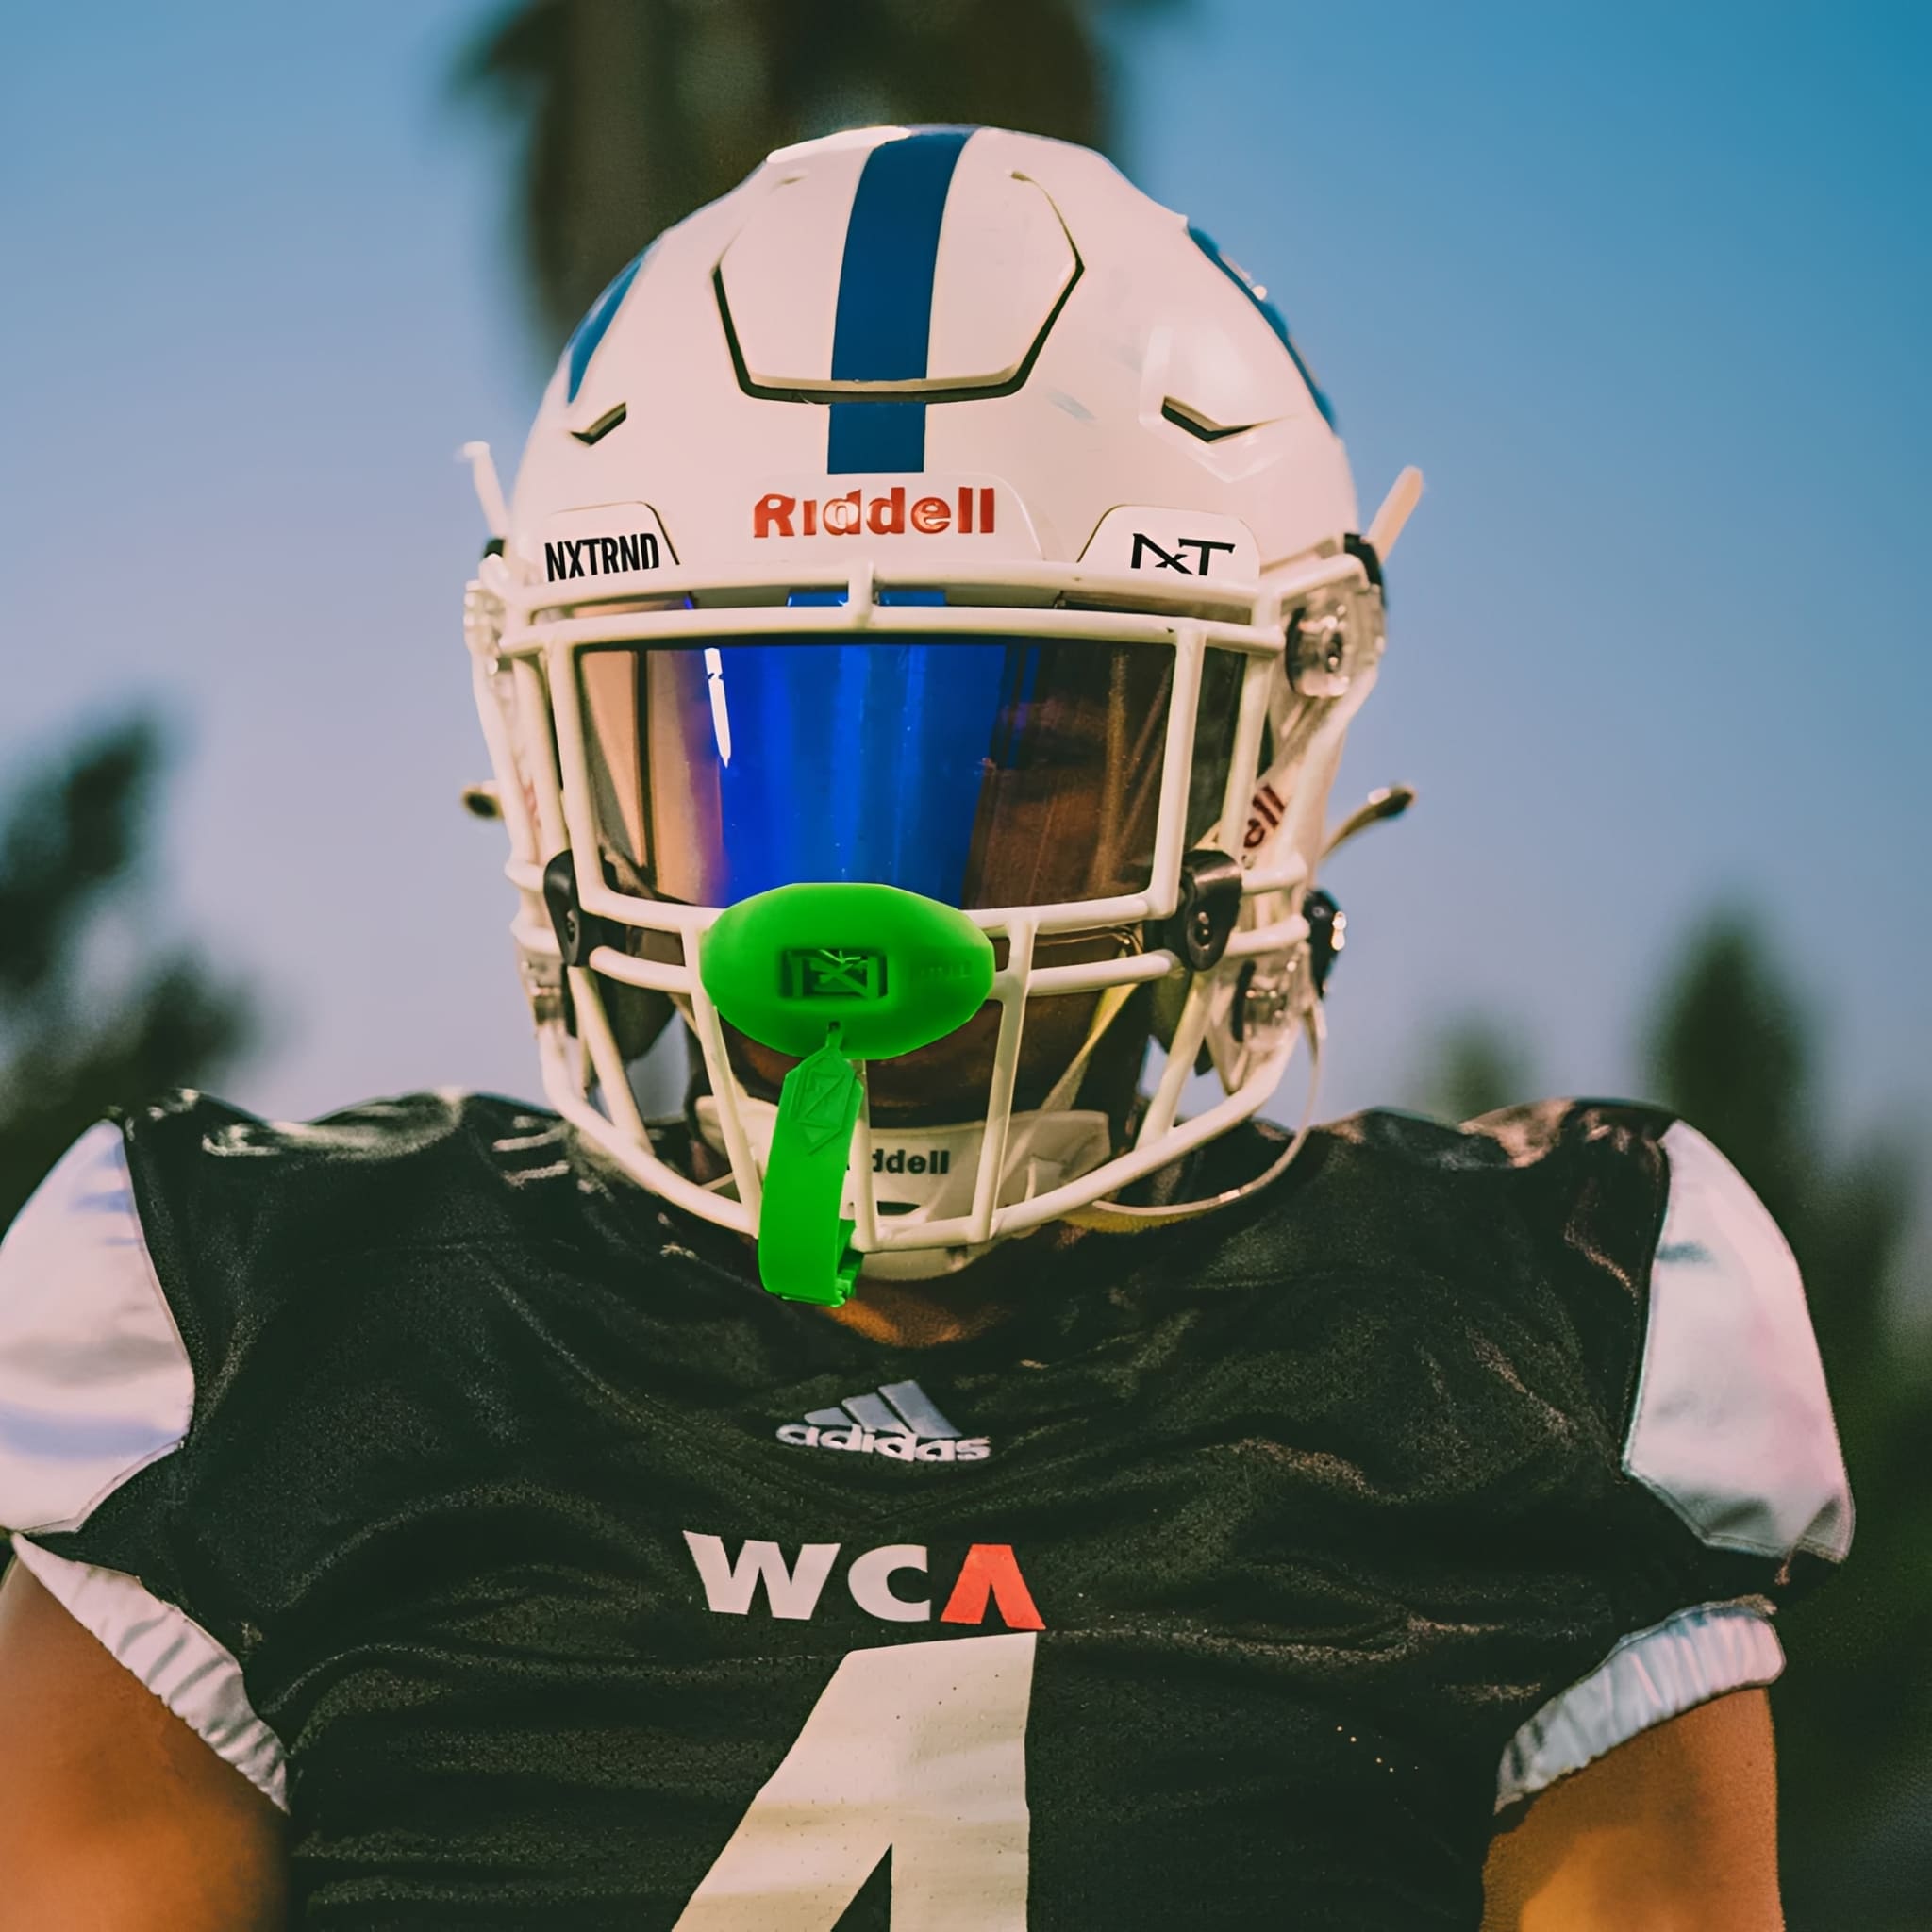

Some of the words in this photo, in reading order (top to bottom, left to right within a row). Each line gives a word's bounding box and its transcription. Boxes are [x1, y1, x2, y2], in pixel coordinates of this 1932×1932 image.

[754, 487, 995, 538] Riddell
[544, 533, 659, 582] NXTRND
[872, 1148, 950, 1174] ddell
[775, 1424, 991, 1462] adidas
[682, 1530, 1046, 1630] WCA
